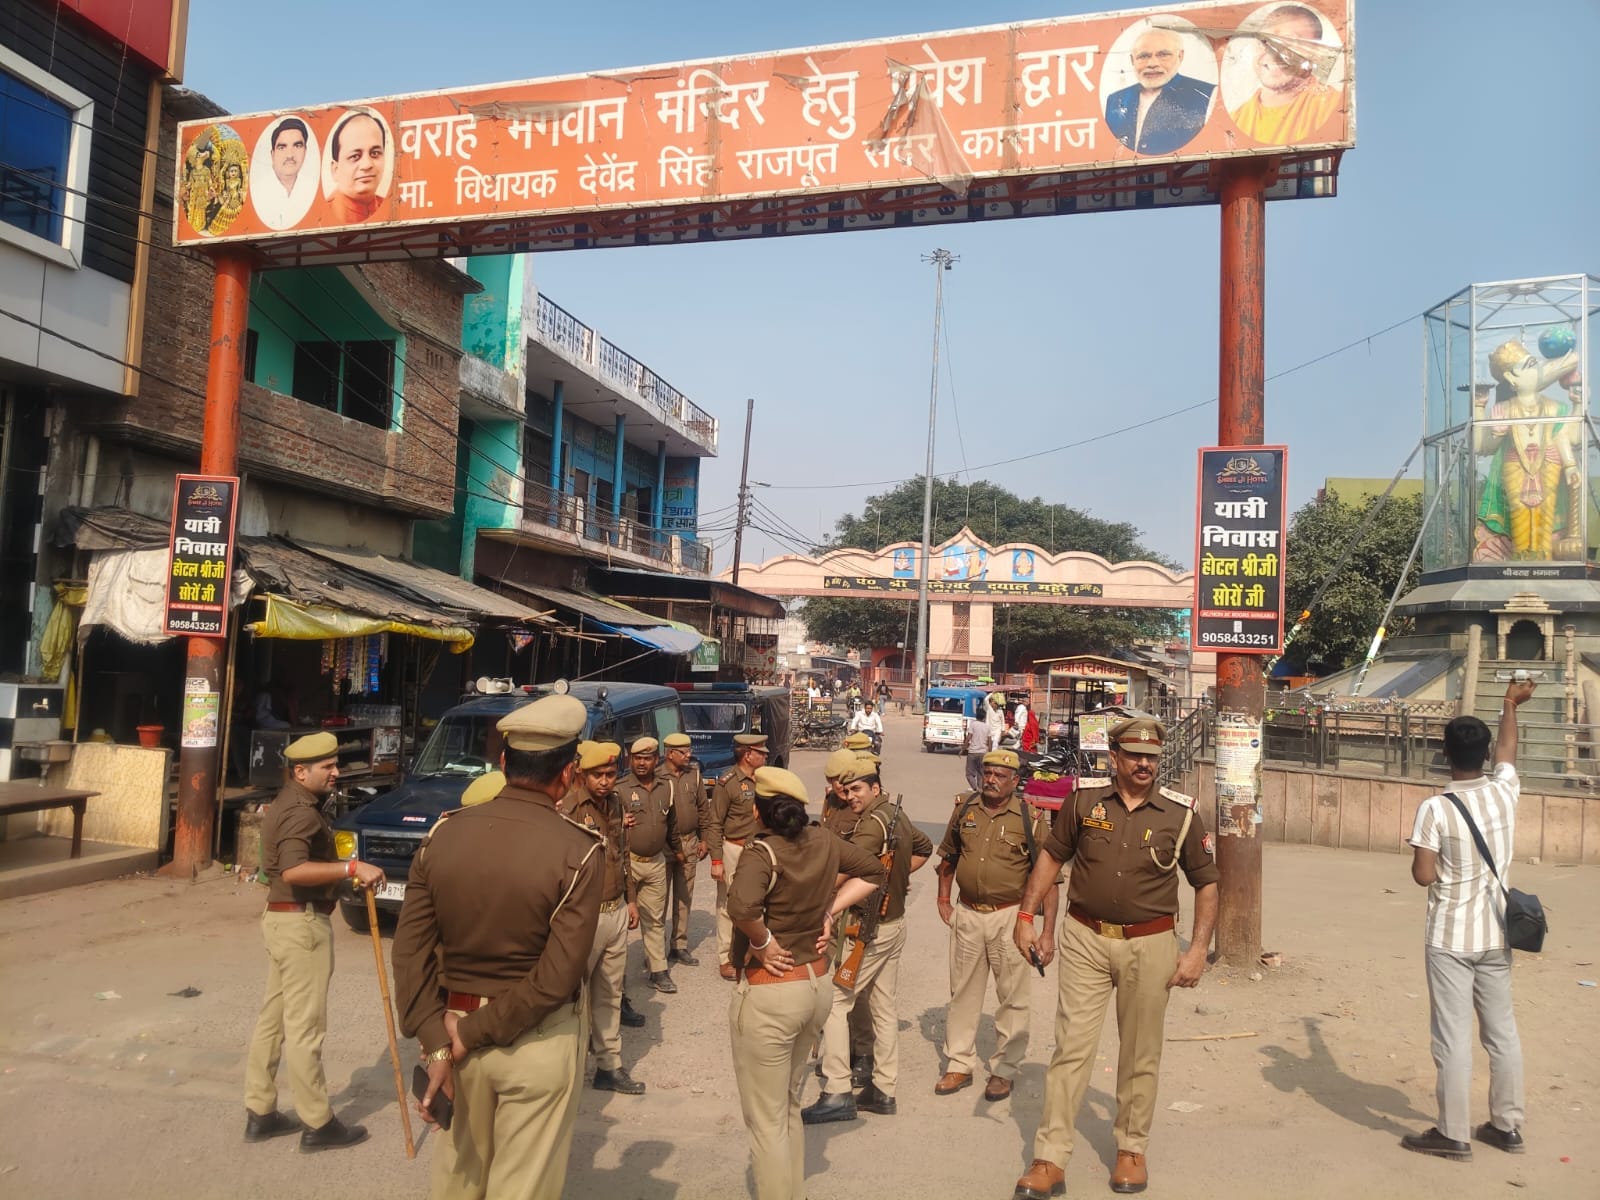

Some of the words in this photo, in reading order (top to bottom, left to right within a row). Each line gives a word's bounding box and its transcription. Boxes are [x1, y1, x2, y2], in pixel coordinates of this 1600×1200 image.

[400, 113, 478, 160] वराह
[801, 56, 859, 140] हेतु
[1018, 45, 1099, 107] द्वार
[399, 180, 433, 209] मा.
[455, 165, 559, 205] विधायक
[657, 145, 716, 188] सिंह
[736, 143, 840, 187] राजपूत
[960, 110, 1098, 160] कासगंज
[1214, 497, 1268, 519] यात्री
[184, 516, 222, 534] यात्री
[175, 537, 227, 556] निवास
[1203, 525, 1279, 548] निवास
[173, 558, 199, 578] होटल
[200, 559, 226, 579] श्रीजी
[1202, 553, 1239, 576] होटल
[1241, 553, 1278, 577] श्रीजी
[201, 584, 216, 602] जी
[1213, 583, 1243, 607] सोरों
[1245, 583, 1266, 607] जी
[170, 620, 220, 631] 9058433251
[1202, 632, 1274, 645] 9058433251
